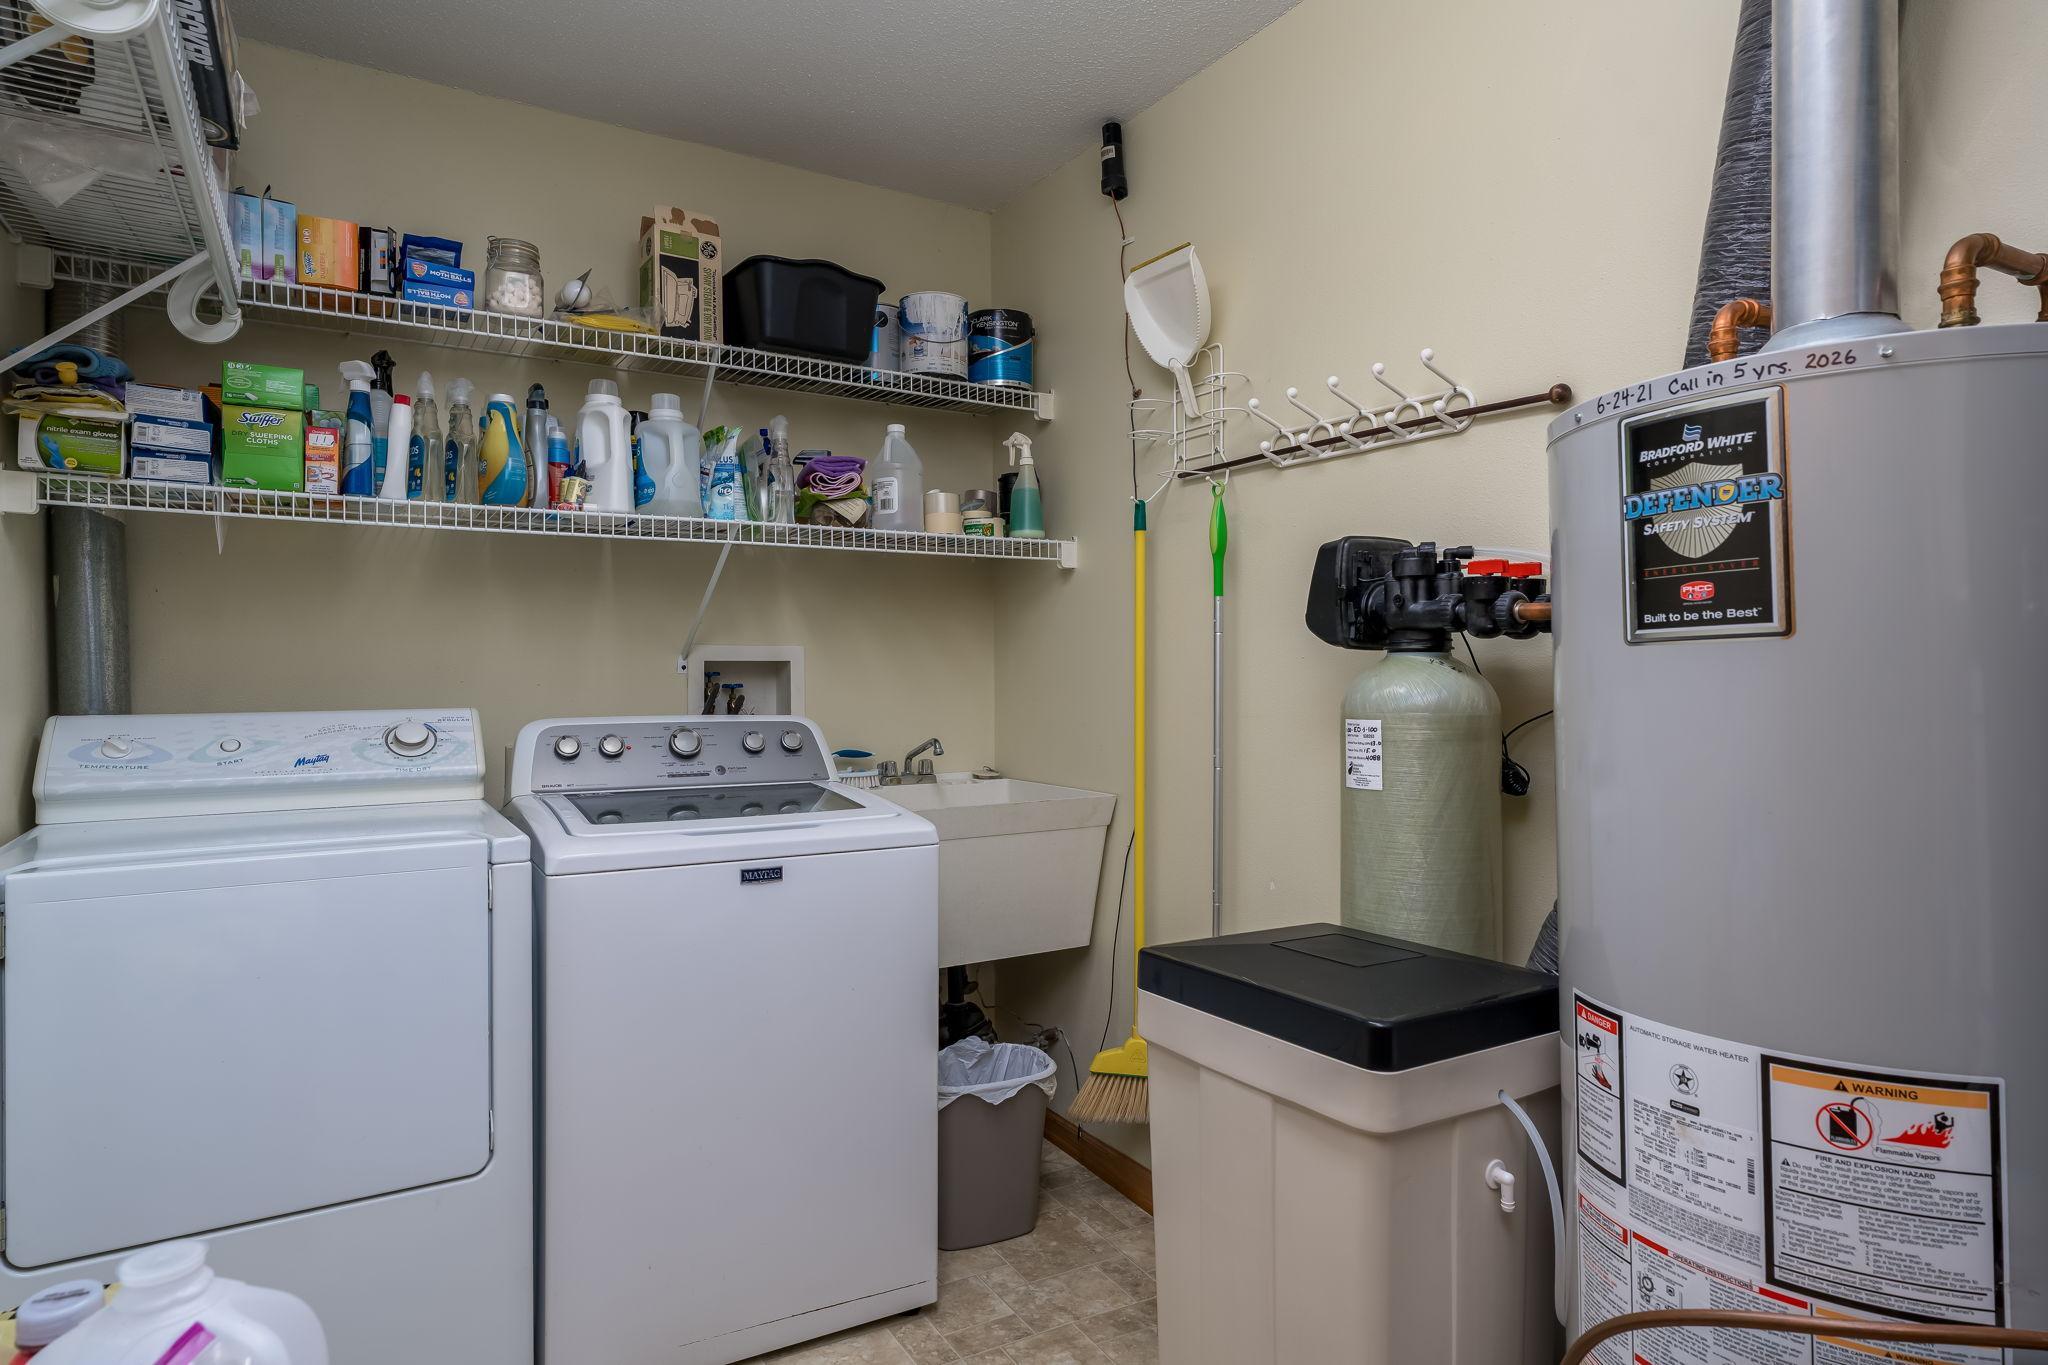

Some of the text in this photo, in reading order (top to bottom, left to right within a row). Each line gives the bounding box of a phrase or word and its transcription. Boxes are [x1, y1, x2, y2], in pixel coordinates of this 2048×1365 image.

[450, 274, 472, 283] BALLS
[1597, 350, 1856, 414] 6-24-21 Call in 5 yrs. 2026
[238, 412, 284, 427] Swiffer
[46, 425, 68, 434] nitrile
[93, 430, 118, 439] gloves
[250, 432, 293, 441] SWEEPING
[1640, 433, 1753, 462] BRADFORD WHITE
[1647, 446, 1743, 468] CORPORATION
[1624, 472, 1784, 521] DEFENDER
[1644, 512, 1752, 535] SAFETY SYSTEM
[1643, 560, 1759, 577] ENERGY SAVER
[1644, 614, 1666, 623] Built
[1669, 613, 1680, 622] to
[1684, 612, 1699, 620] be
[1702, 610, 1723, 619] the
[217, 758, 244, 767] START
[294, 754, 330, 767] Maytag
[743, 869, 781, 880] MAYTAG
[1588, 1012, 1611, 1030] DANGER
[1630, 1025, 1749, 1063] AUTOMATIC STORAGE WATER HEATER
[1852, 1083, 1919, 1100] WARNING
[1876, 1146, 1941, 1161] Flammable Vapors
[1816, 1154, 1935, 1179] FIRE AND EXPLOSION HAZARD
[1861, 1170, 1883, 1178] serious
[1813, 1166, 1828, 1174] store
[1852, 1174, 1878, 1184] gasoline
[1907, 1184, 1940, 1193] flammable
[1672, 1253, 1705, 1272] OPERATING
[1707, 1268, 1753, 1290] INSTRUCTIONS
[1829, 1345, 1849, 1354] WATER
[1896, 1354, 1934, 1365] WARNING
